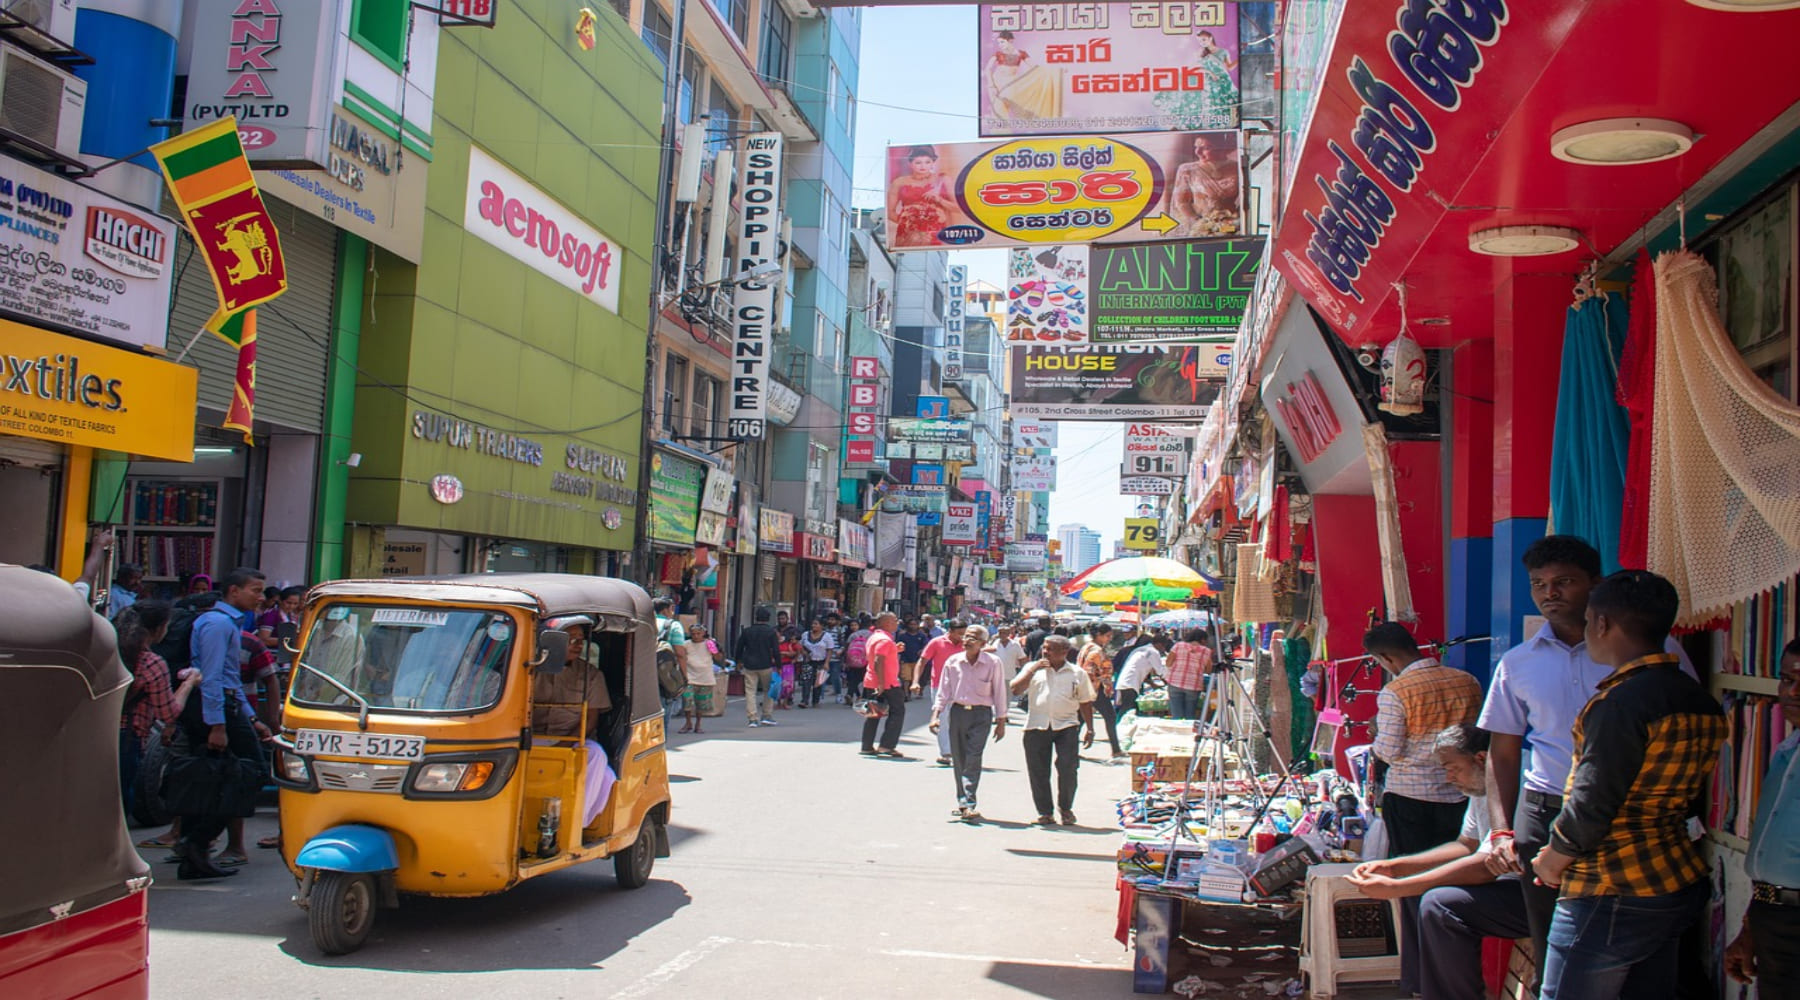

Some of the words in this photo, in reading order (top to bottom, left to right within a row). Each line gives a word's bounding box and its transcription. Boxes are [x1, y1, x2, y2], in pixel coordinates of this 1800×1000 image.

[192, 104, 289, 120] (PVT)LTD
[747, 139, 776, 150] NEW
[994, 148, 1055, 169] සානියා
[314, 180, 345, 208] Dealers
[1009, 209, 1113, 229] සෙන්ටර්
[96, 209, 162, 262] HACHI
[478, 180, 613, 295] aerosoft
[72, 267, 127, 295] සමාගම
[1098, 293, 1214, 310] INTERNATIONAL
[946, 266, 964, 361] Suguna
[734, 305, 765, 410] CENTRE
[1025, 355, 1117, 371] HOUSE
[13, 408, 27, 419] ALL
[29, 411, 47, 423] KIND
[48, 414, 58, 424] OF
[60, 416, 87, 430] TEXTILE
[88, 421, 116, 435] FABRICS
[1063, 407, 1086, 415] Cross
[1088, 407, 1113, 415] Street
[1114, 408, 1155, 416] Colombo
[28, 424, 64, 437] COLOMBO
[412, 410, 472, 449] SUPUN
[476, 426, 543, 467] TRADERS
[729, 419, 762, 437] 106
[565, 443, 627, 483] SUPUN
[1135, 455, 1163, 473] 91
[1127, 525, 1158, 542] 79
[296, 740, 313, 751] CP
[318, 733, 343, 753] YR
[366, 737, 422, 758] 5123
